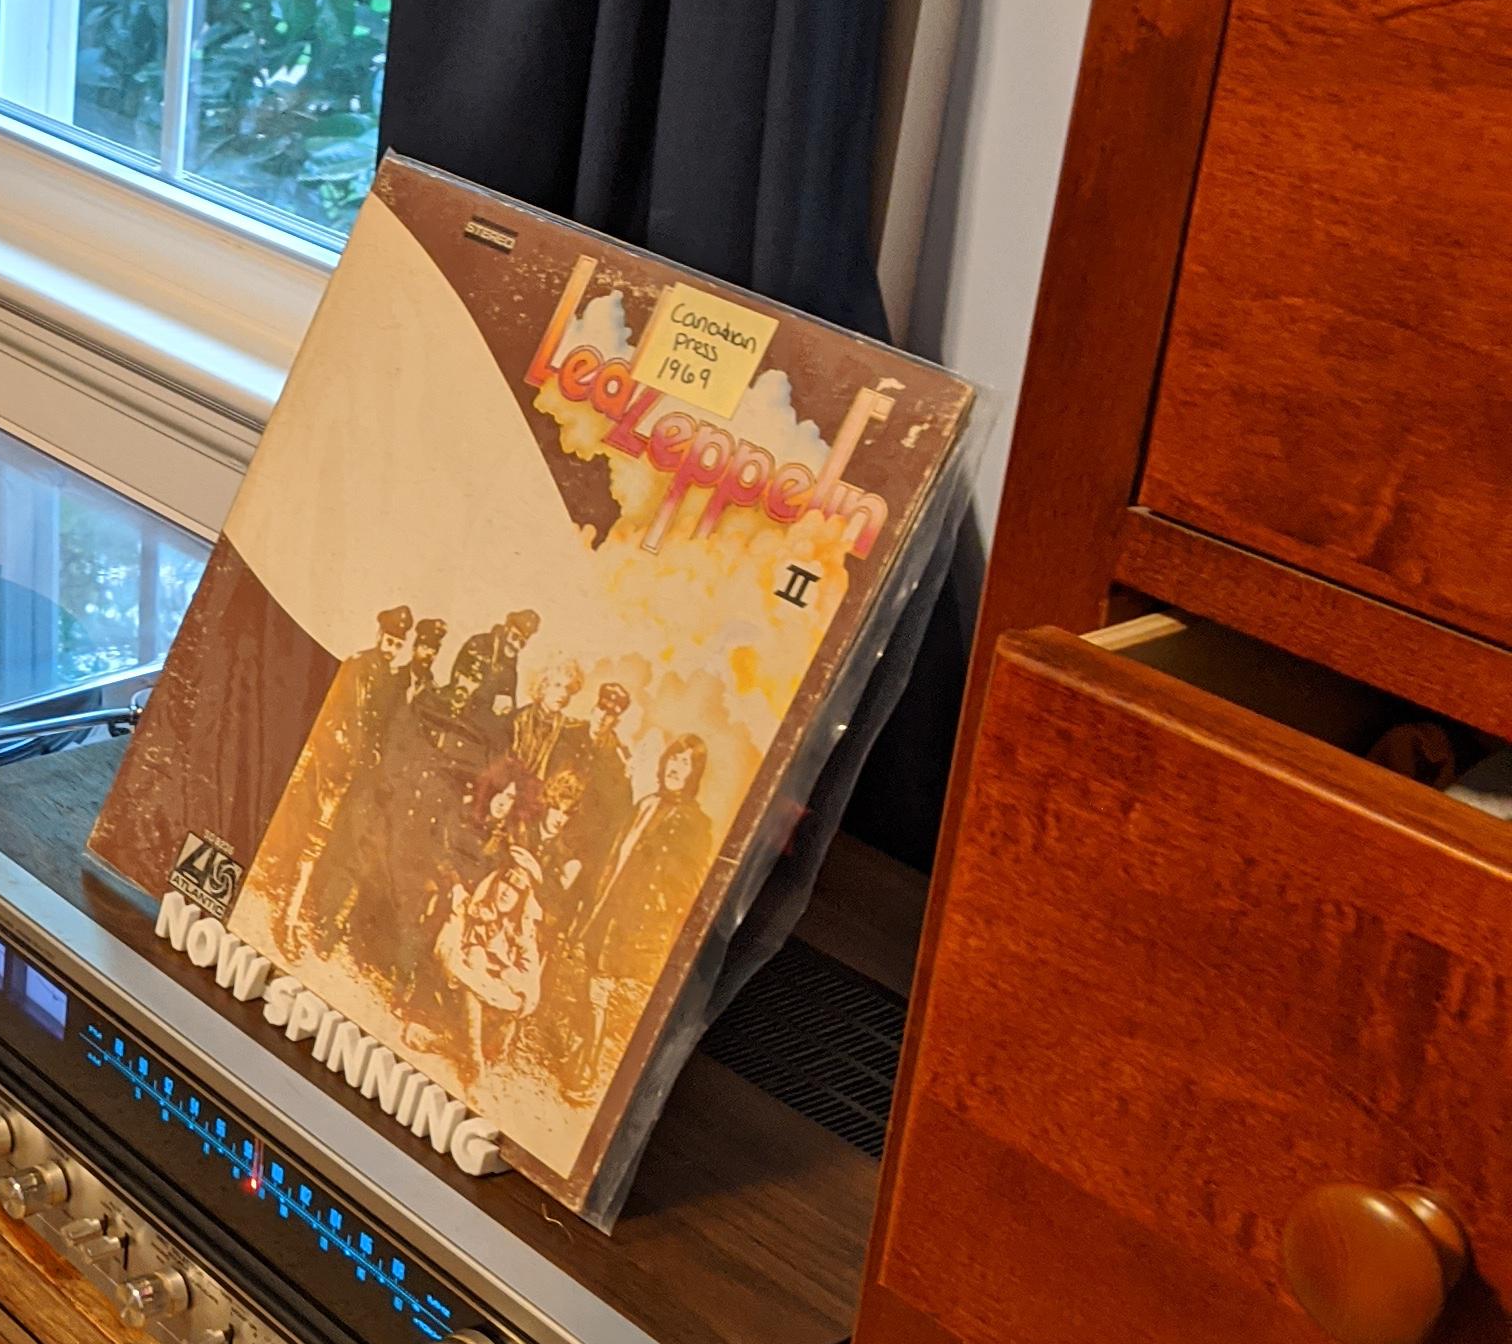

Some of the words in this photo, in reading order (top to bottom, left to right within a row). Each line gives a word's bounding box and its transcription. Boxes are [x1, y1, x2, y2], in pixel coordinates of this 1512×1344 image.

[464, 221, 516, 249] STEREO
[670, 302, 757, 354] Canadian
[656, 356, 711, 389] 1969
[603, 387, 888, 560] Zeppelin
[774, 563, 821, 608] II
[171, 874, 226, 917] ATLANTIC
[154, 890, 272, 1002] NOW
[262, 975, 502, 1177] SPINNING
